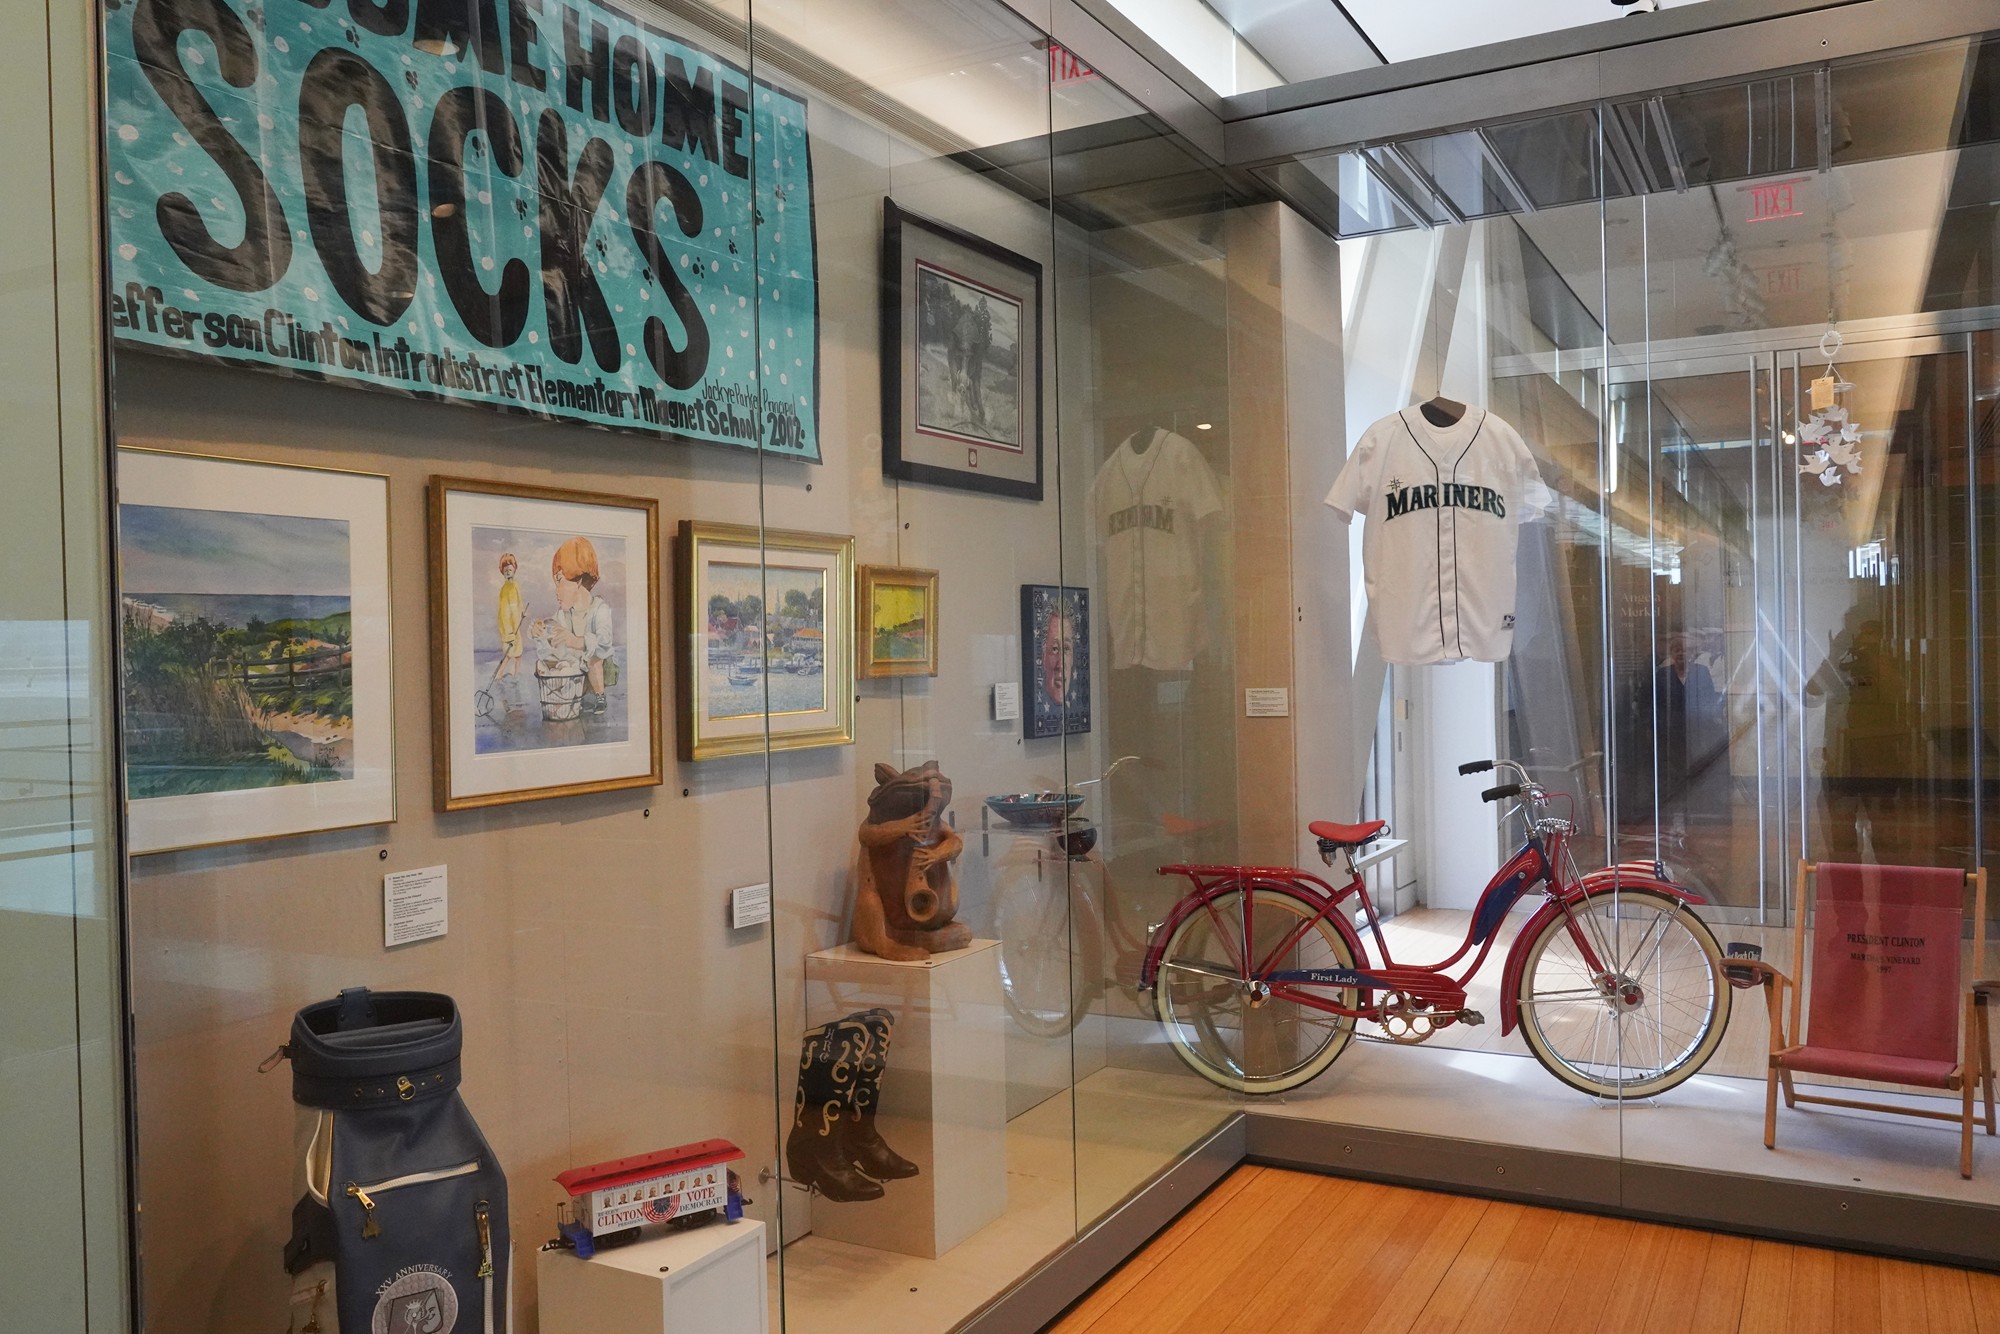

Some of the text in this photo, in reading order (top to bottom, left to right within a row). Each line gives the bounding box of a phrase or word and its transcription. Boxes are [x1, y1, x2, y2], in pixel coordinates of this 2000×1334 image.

[562, 3, 749, 180] HOME
[131, 0, 709, 390] SOCKS
[113, 281, 263, 352] efferson
[264, 308, 375, 375] Clinton
[373, 331, 529, 400] Intradistrict
[524, 364, 640, 420] Elementary
[638, 385, 705, 432] Magnet
[705, 400, 757, 442] School
[1384, 482, 1506, 523] MARINERS
[1847, 933, 1925, 947] PRESIDENT CLINTON
[1311, 972, 1358, 985] First Lady
[679, 1196, 723, 1212] DEMOCRAT!
[686, 1186, 716, 1203] VOTE
[597, 1207, 644, 1228] CLINTON
[395, 1263, 453, 1281] ANNIVERSARY
